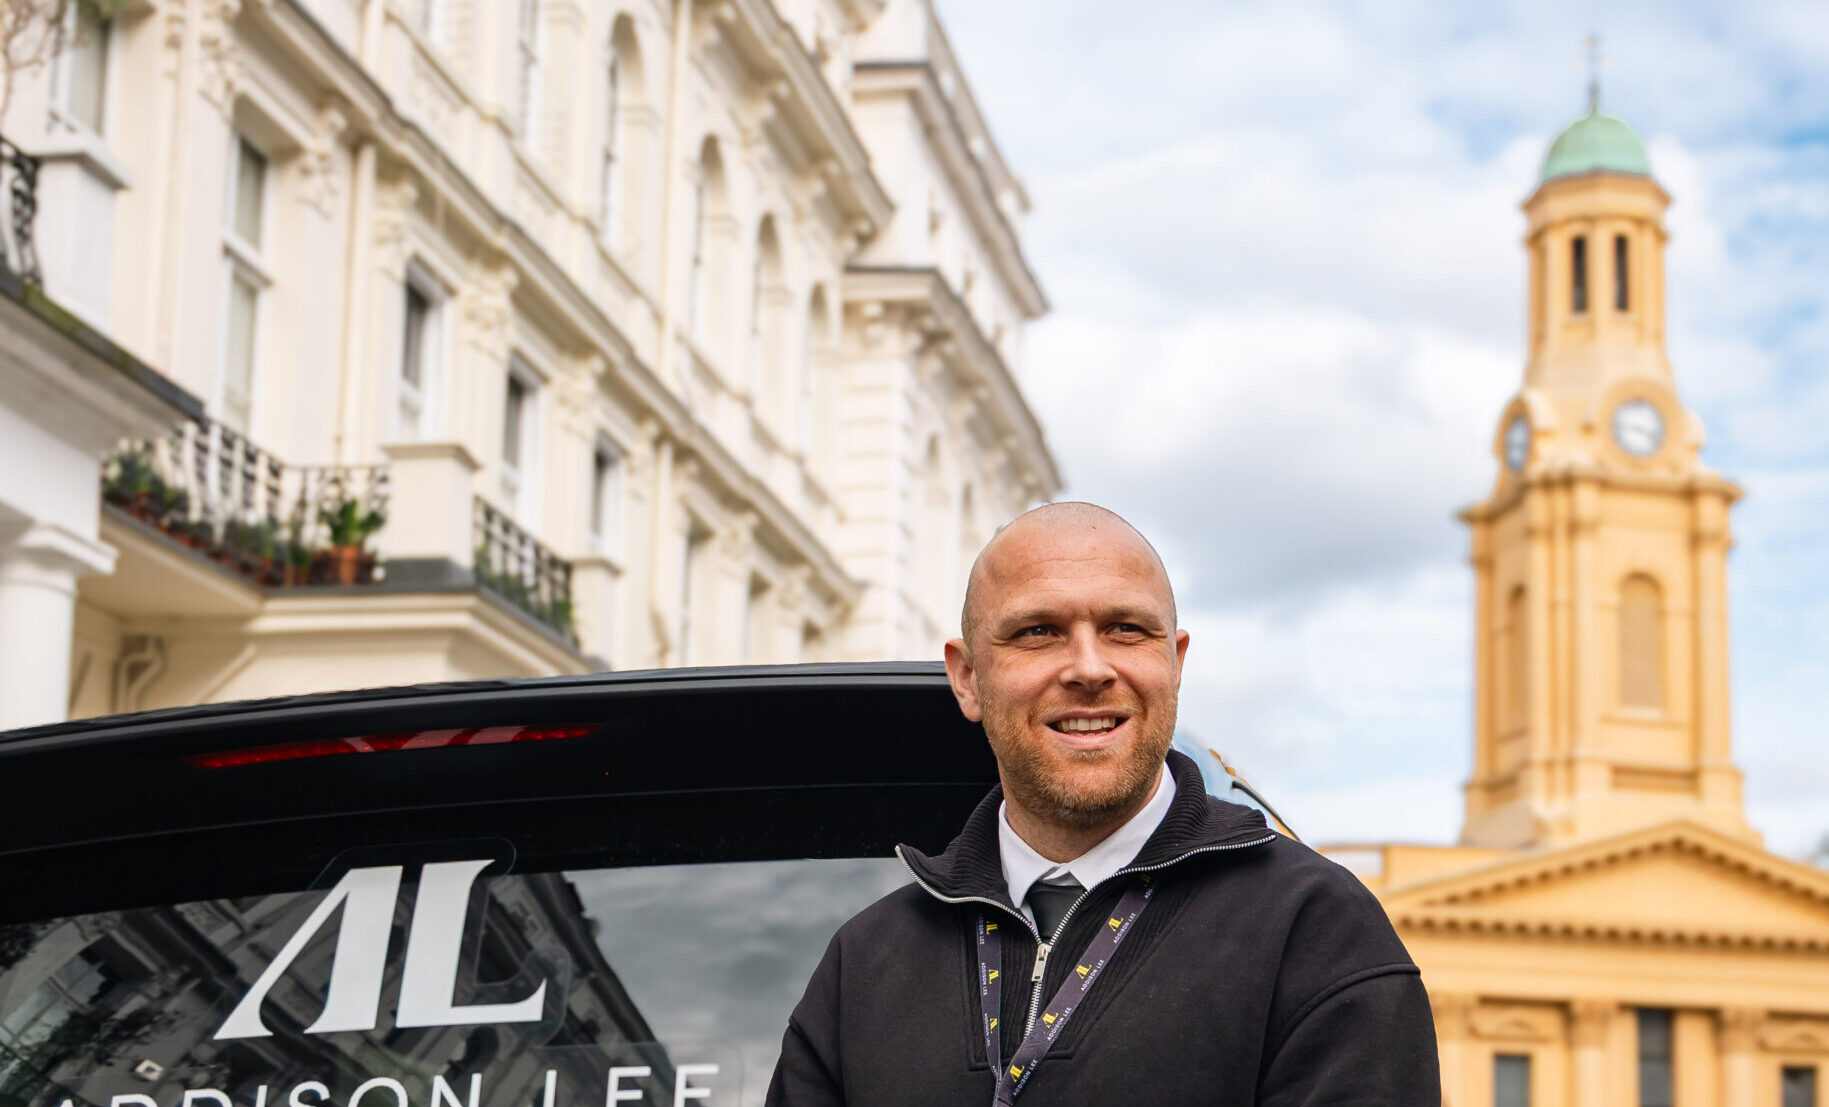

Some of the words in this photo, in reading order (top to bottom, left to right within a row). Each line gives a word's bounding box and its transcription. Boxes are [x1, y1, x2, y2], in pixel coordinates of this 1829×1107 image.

[1113, 922, 1130, 944] ADDISON
[1127, 912, 1137, 922] LEE
[214, 859, 547, 1040] AL
[1080, 968, 1098, 992] ADDISON
[1095, 959, 1105, 969] LEE
[1047, 1017, 1065, 1041] ADDISON
[1062, 1006, 1072, 1018] LEE
[1013, 1071, 1031, 1096] ADDISON
[1028, 1059, 1039, 1071] LEE
